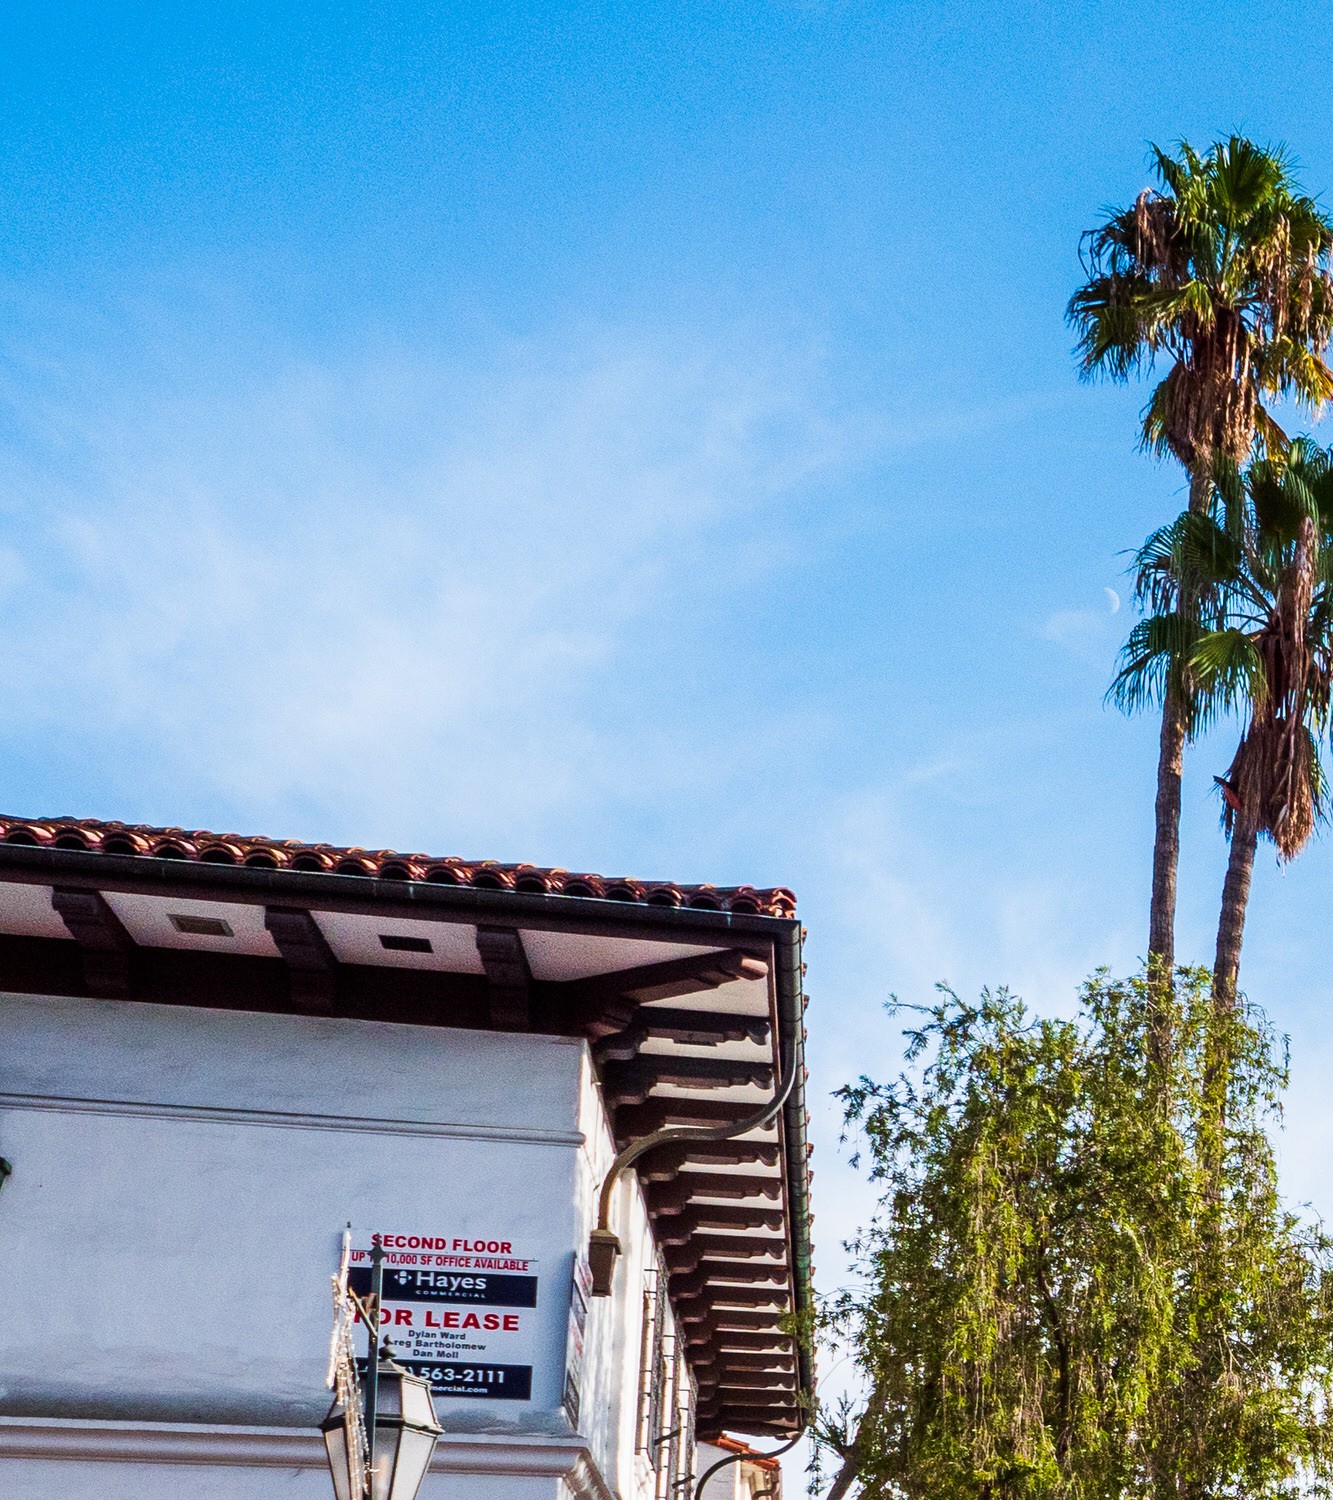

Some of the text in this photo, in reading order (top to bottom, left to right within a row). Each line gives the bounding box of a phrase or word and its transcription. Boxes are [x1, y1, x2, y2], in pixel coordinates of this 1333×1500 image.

[371, 1234, 512, 1254] SECOND FLOOR
[351, 1252, 365, 1262] UP
[385, 1254, 417, 1266] 10,000
[421, 1256, 432, 1265] SF
[436, 1256, 471, 1268] OFFICE
[474, 1260, 528, 1271] AVAILABLE
[416, 1271, 487, 1291] Hayes
[416, 1290, 486, 1298] COMMERCIAL
[425, 1311, 519, 1331] LEASE
[408, 1330, 466, 1340] Dylan Ward
[391, 1340, 486, 1350] reg Bartholomew
[413, 1350, 458, 1358] Dan Moll
[420, 1368, 504, 1384] 563-2111
[430, 1384, 488, 1394] mercial.com
